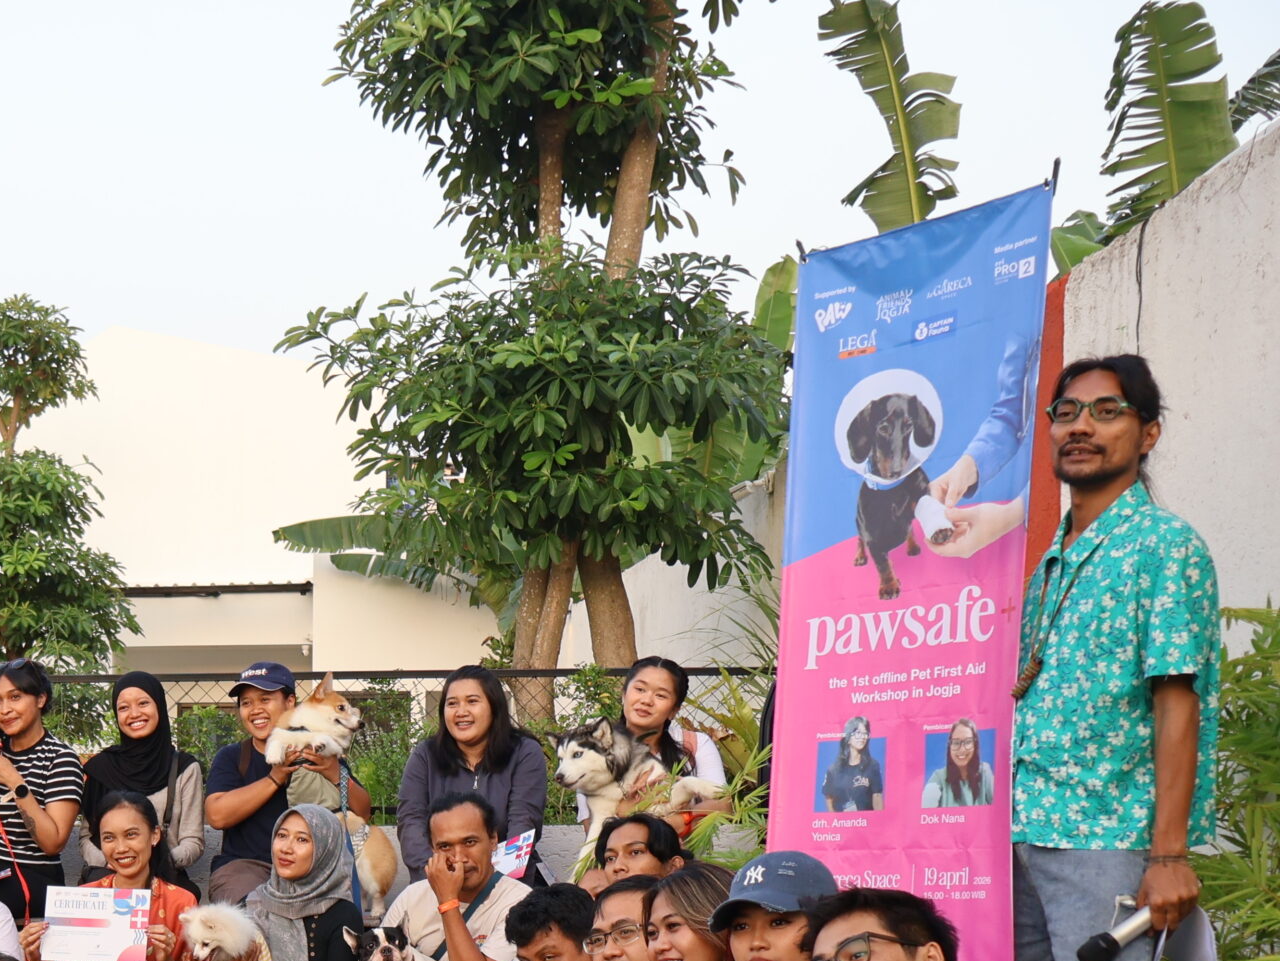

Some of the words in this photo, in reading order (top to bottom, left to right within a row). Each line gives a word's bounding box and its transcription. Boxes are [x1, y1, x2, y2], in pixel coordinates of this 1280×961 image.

[994, 262, 1018, 277] PRO
[814, 301, 853, 333] PAW
[804, 585, 996, 670] pawsafe
[829, 677, 848, 689] the
[851, 675, 870, 688] 1st
[872, 671, 908, 685] offline
[910, 668, 931, 681] Pet
[934, 664, 962, 678] First
[965, 661, 987, 675] Aid
[851, 689, 909, 704] Workshop
[912, 686, 924, 699] in
[926, 683, 961, 700] Jogja
[812, 819, 830, 829] drh.
[832, 817, 867, 828] Amanda
[920, 814, 939, 825] Dok
[941, 813, 965, 824] Nana
[812, 832, 841, 842] Yonica
[832, 873, 861, 888] reca
[923, 867, 938, 886] 19
[938, 866, 969, 889] april
[973, 876, 992, 885] 2026
[923, 891, 942, 899] 15.00
[951, 891, 970, 899] 18.00
[970, 890, 986, 899] WIB
[54, 898, 107, 911] CERTIFICATE
